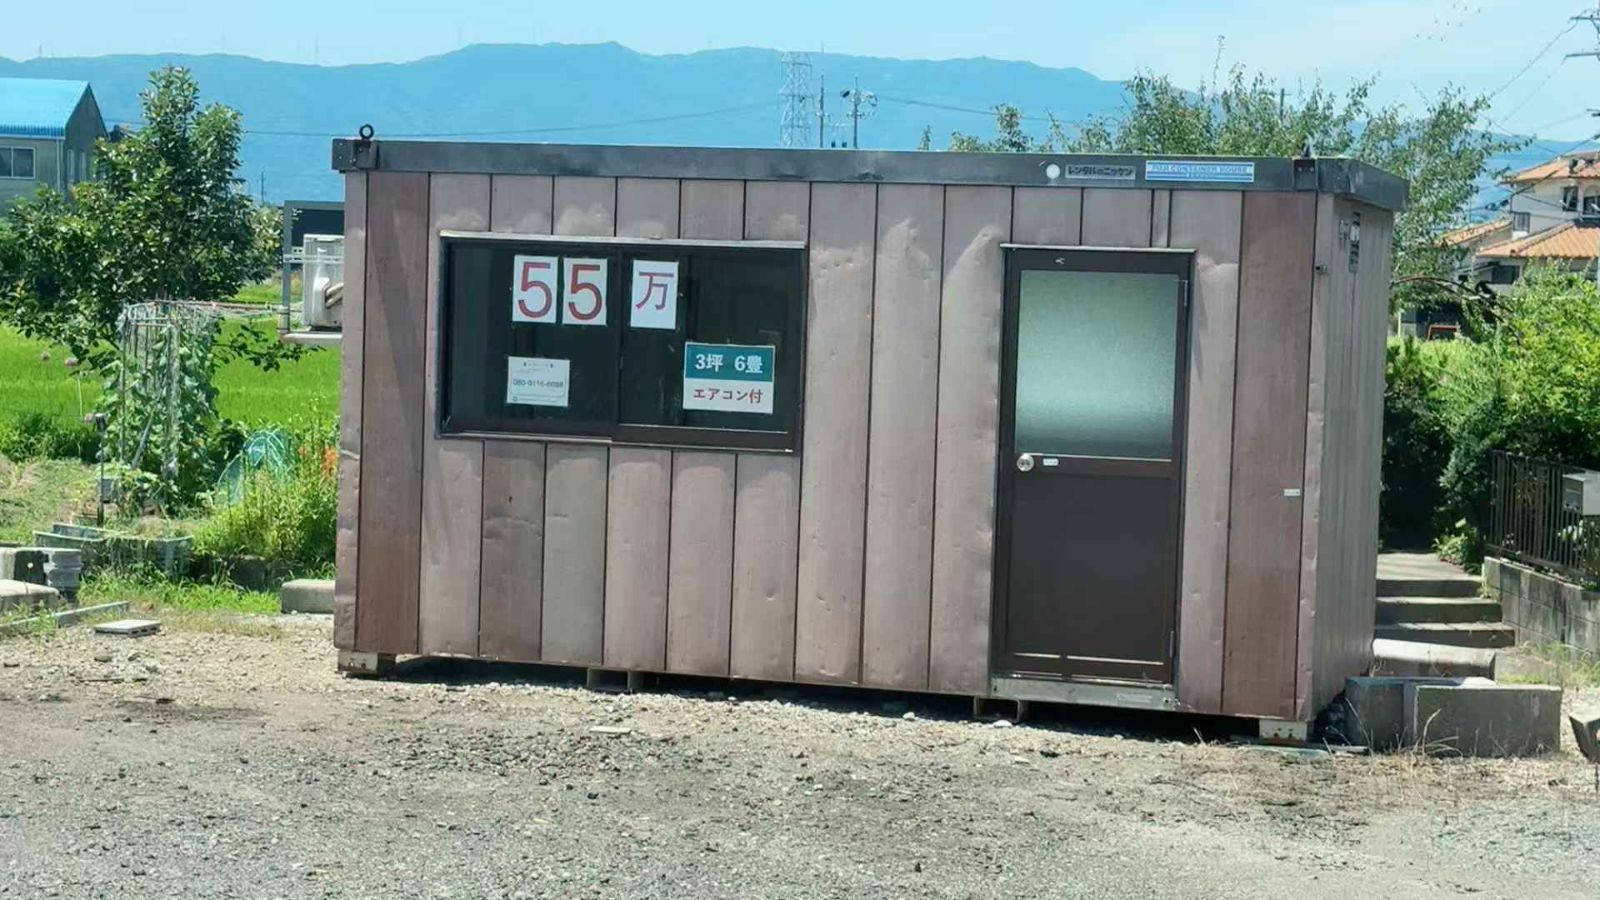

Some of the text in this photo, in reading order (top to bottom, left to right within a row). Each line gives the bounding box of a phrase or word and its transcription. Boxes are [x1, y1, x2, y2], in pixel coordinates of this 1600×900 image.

[1068, 166, 1133, 176] レンタルのニッケン
[1219, 166, 1248, 174] HOUSE
[694, 354, 723, 372] 3坪
[693, 388, 764, 404] エアコン付
